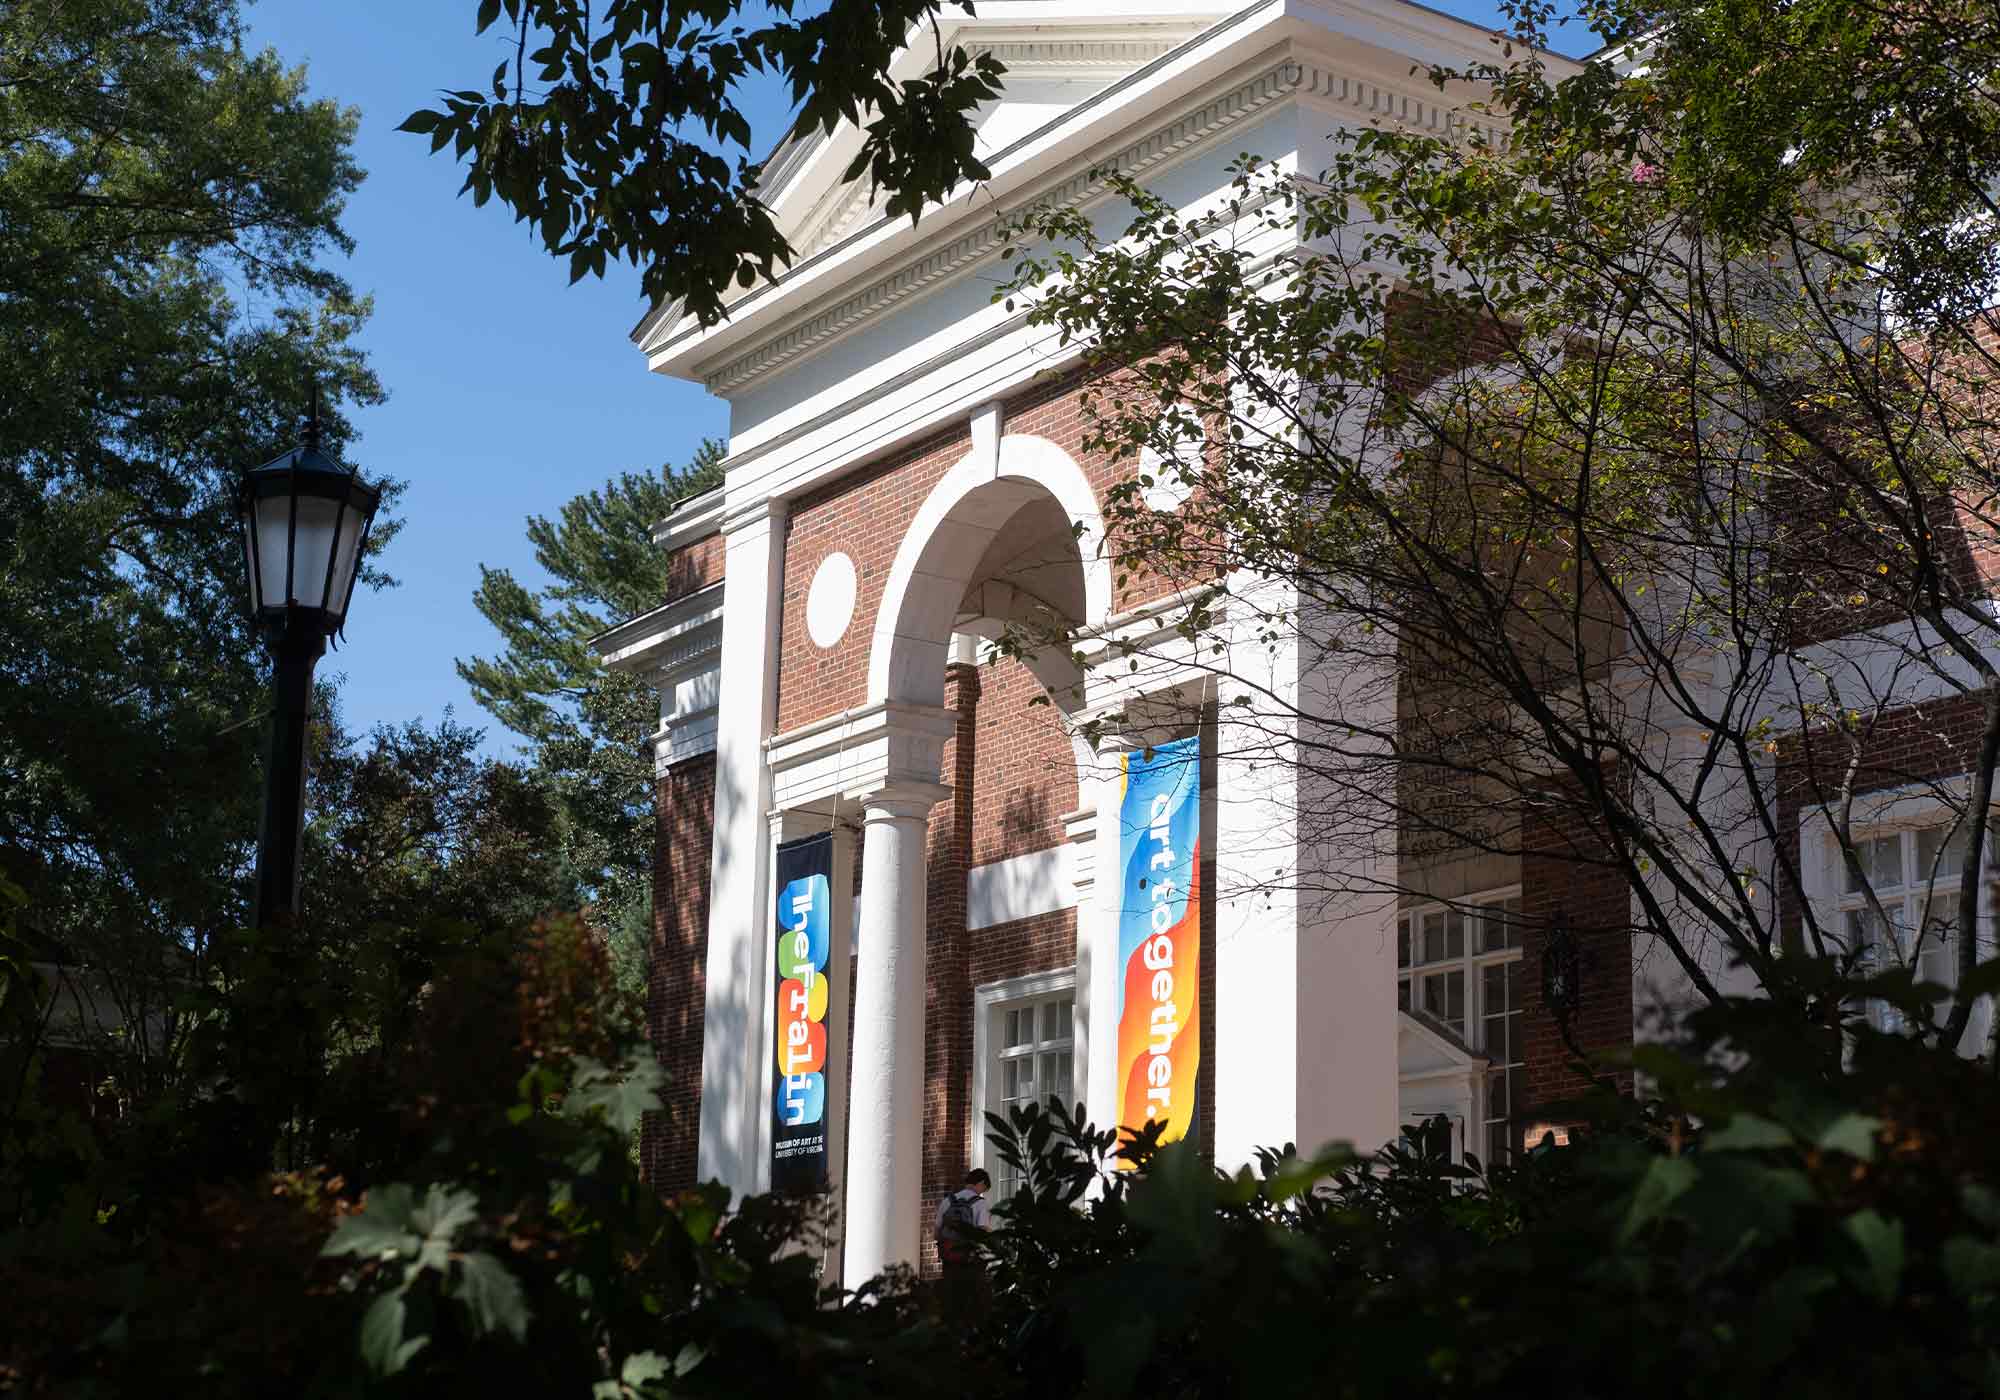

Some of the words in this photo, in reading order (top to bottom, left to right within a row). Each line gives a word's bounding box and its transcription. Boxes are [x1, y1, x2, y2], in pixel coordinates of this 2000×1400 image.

[1150, 793, 1174, 871] art
[1145, 878, 1179, 1118] together.
[792, 1138, 800, 1146] OF
[800, 1138, 811, 1146] ART
[797, 1147, 806, 1155] OF
